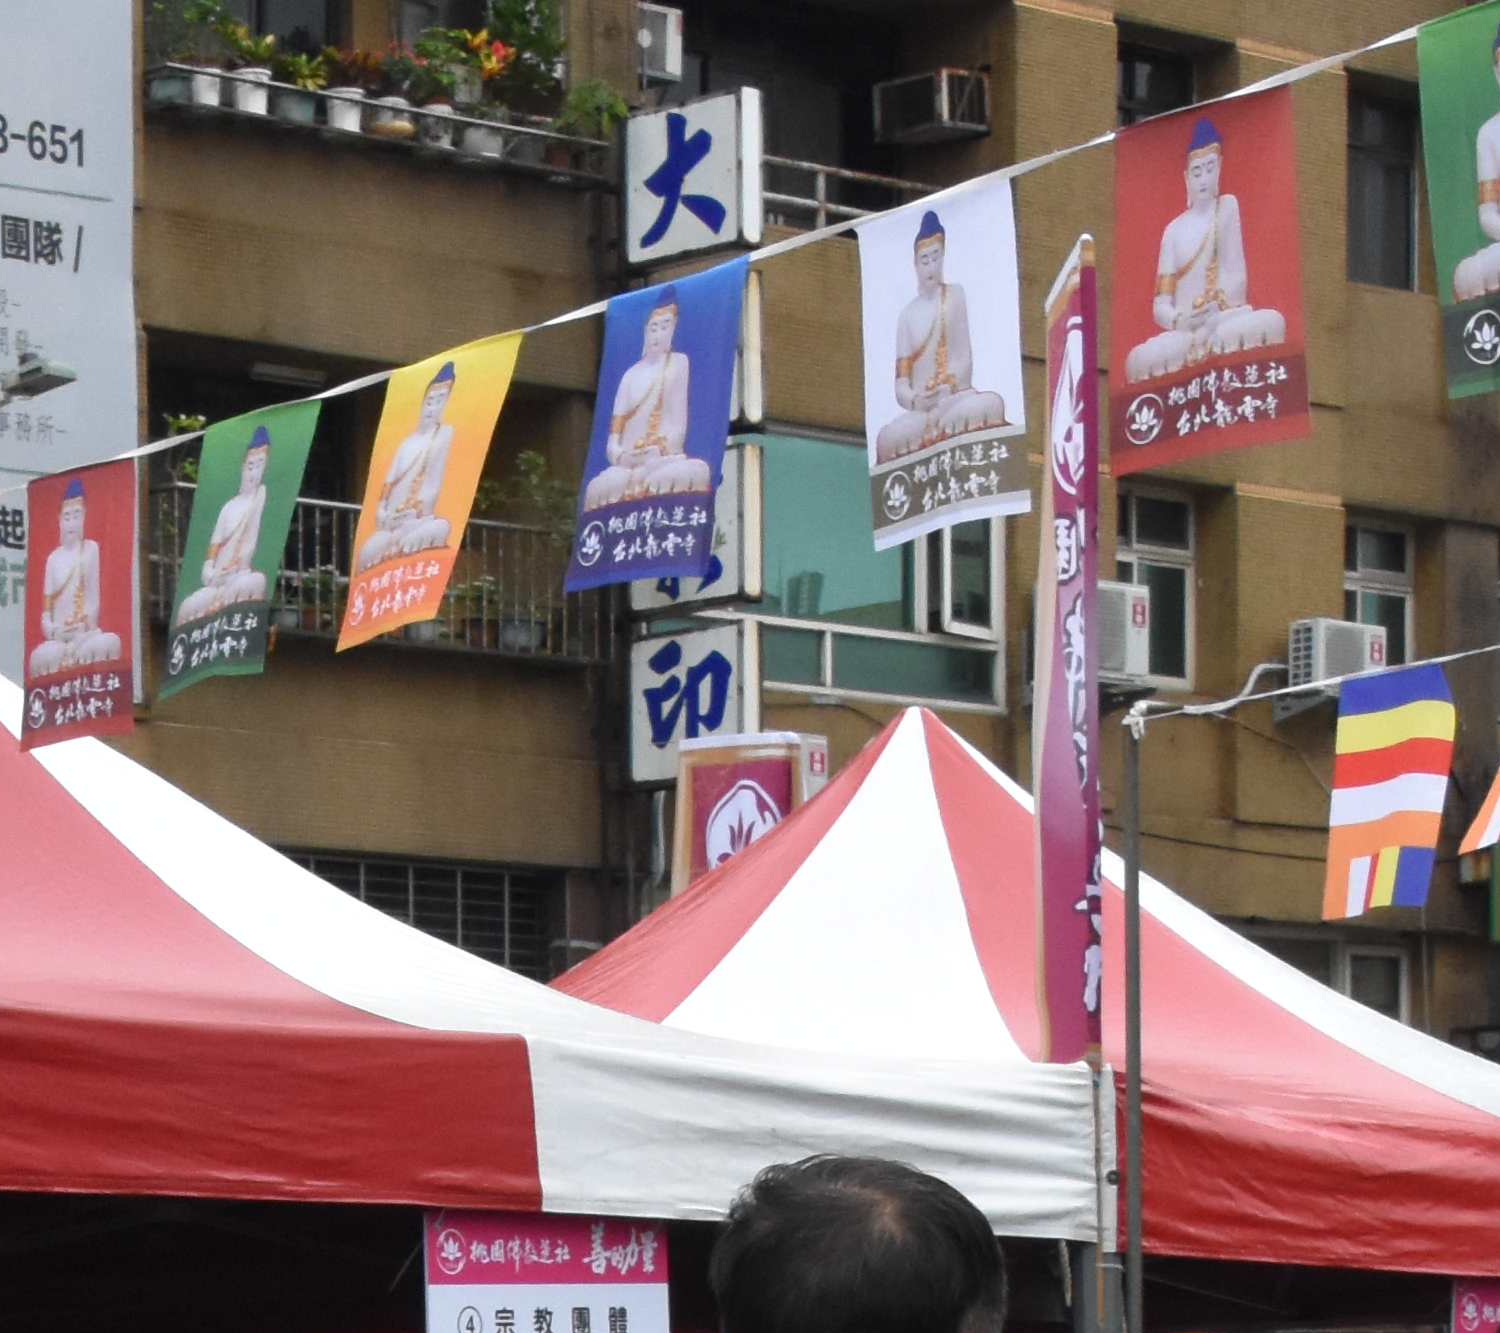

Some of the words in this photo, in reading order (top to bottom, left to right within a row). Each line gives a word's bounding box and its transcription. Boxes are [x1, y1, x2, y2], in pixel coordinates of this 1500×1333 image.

[640, 111, 727, 248] 大
[0, 213, 63, 266] 團隊
[644, 639, 732, 750] 印
[469, 1234, 571, 1274] 桃園佛教蓮社
[583, 1221, 658, 1275] 善的力量
